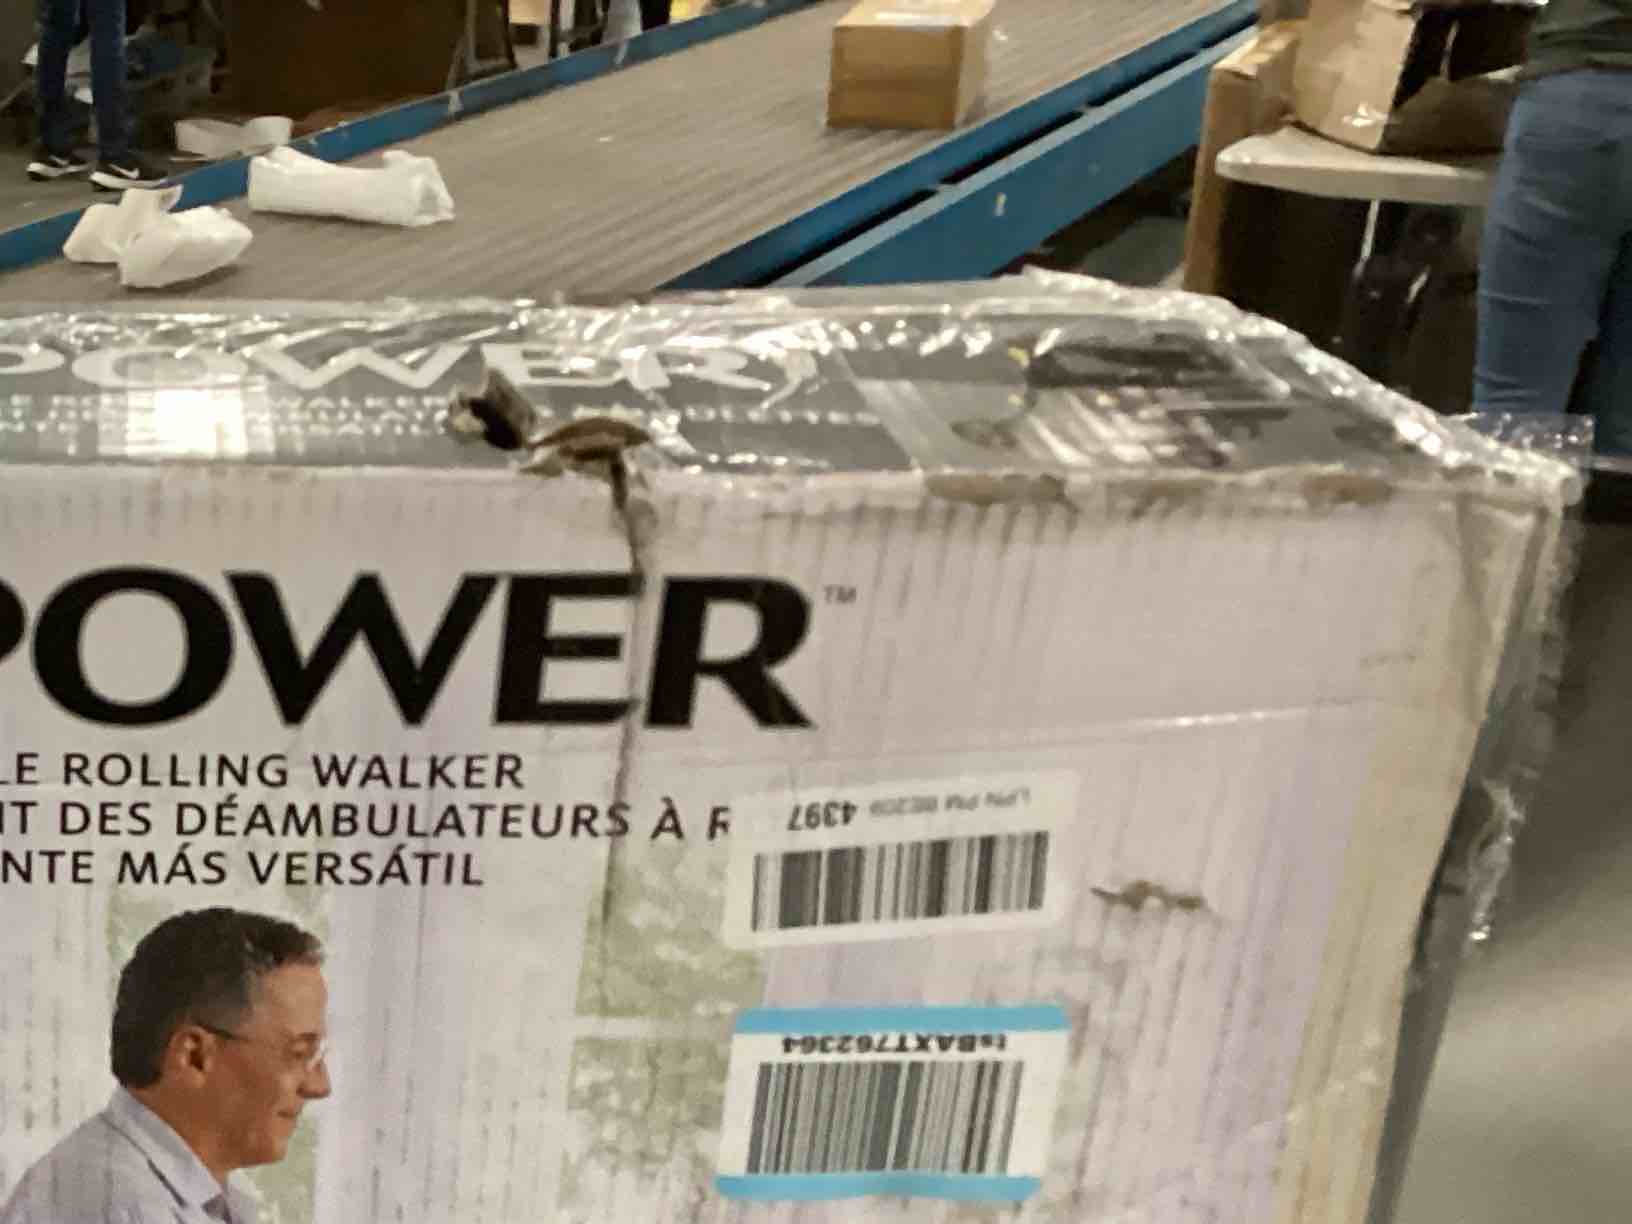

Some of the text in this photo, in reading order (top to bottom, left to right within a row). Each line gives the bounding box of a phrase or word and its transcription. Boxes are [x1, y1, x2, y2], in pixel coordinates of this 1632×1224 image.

[65, 753, 288, 789] ROLLING
[311, 754, 524, 790] WALKER
[61, 802, 151, 837] DES
[176, 795, 631, 839] DÉAMBULATEURS
[650, 797, 684, 841] À
[787, 800, 858, 832] 4397
[117, 842, 226, 886] MÁS
[248, 843, 484, 887] VERSÁTIL
